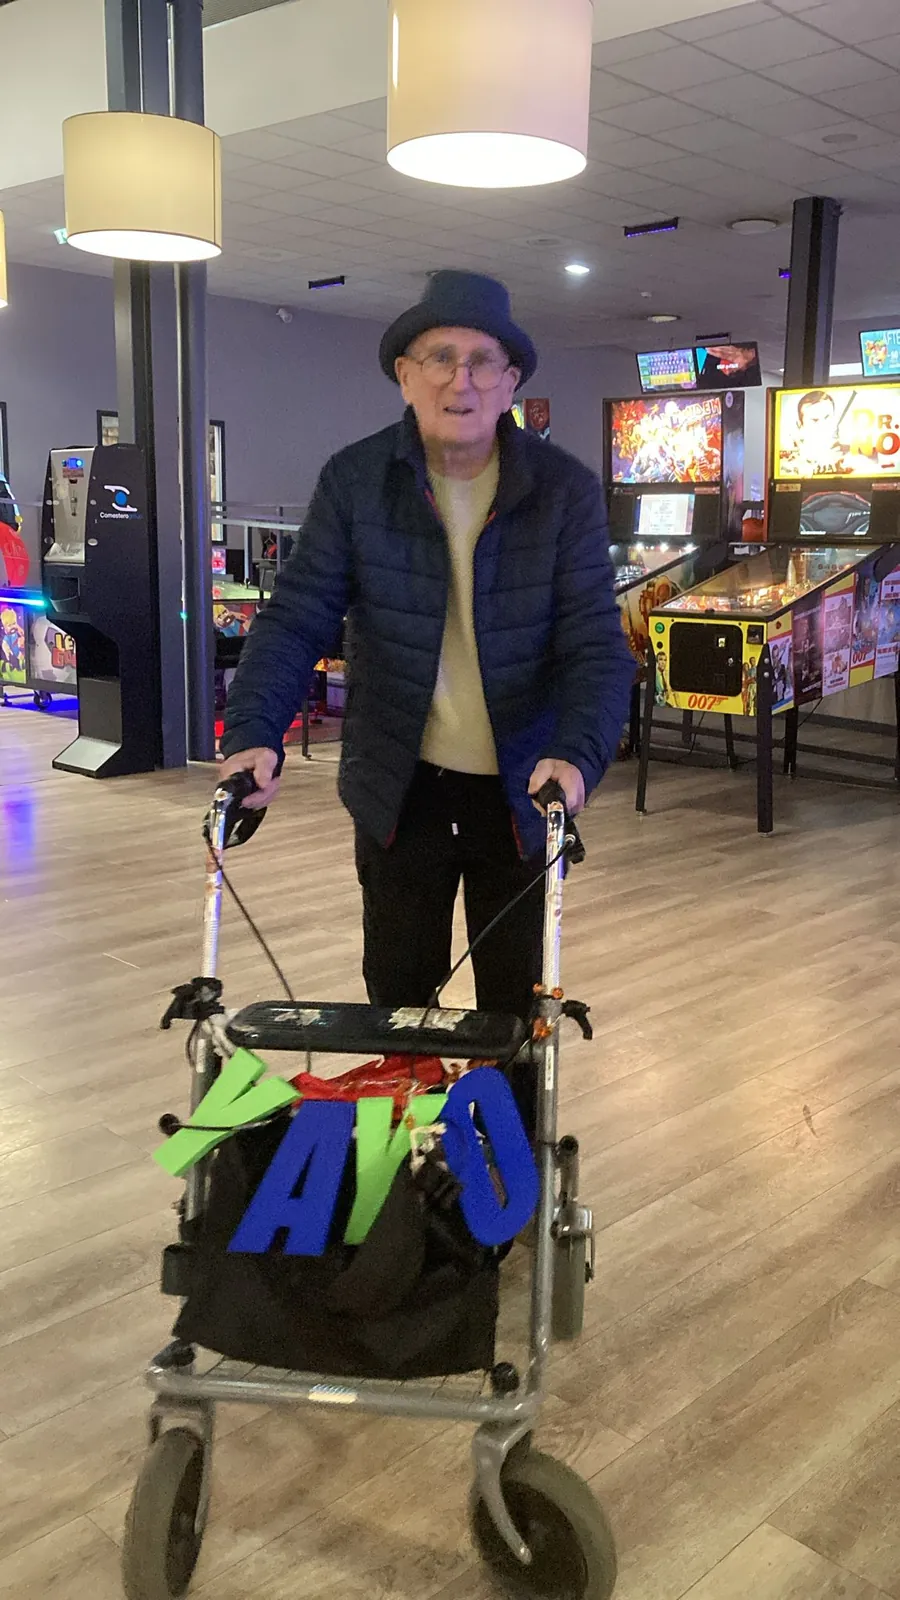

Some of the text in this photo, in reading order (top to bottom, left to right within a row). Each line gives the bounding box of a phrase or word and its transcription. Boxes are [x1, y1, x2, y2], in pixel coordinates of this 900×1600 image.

[851, 407, 899, 430] DR.
[850, 431, 900, 457] NO
[687, 693, 728, 710] 007
